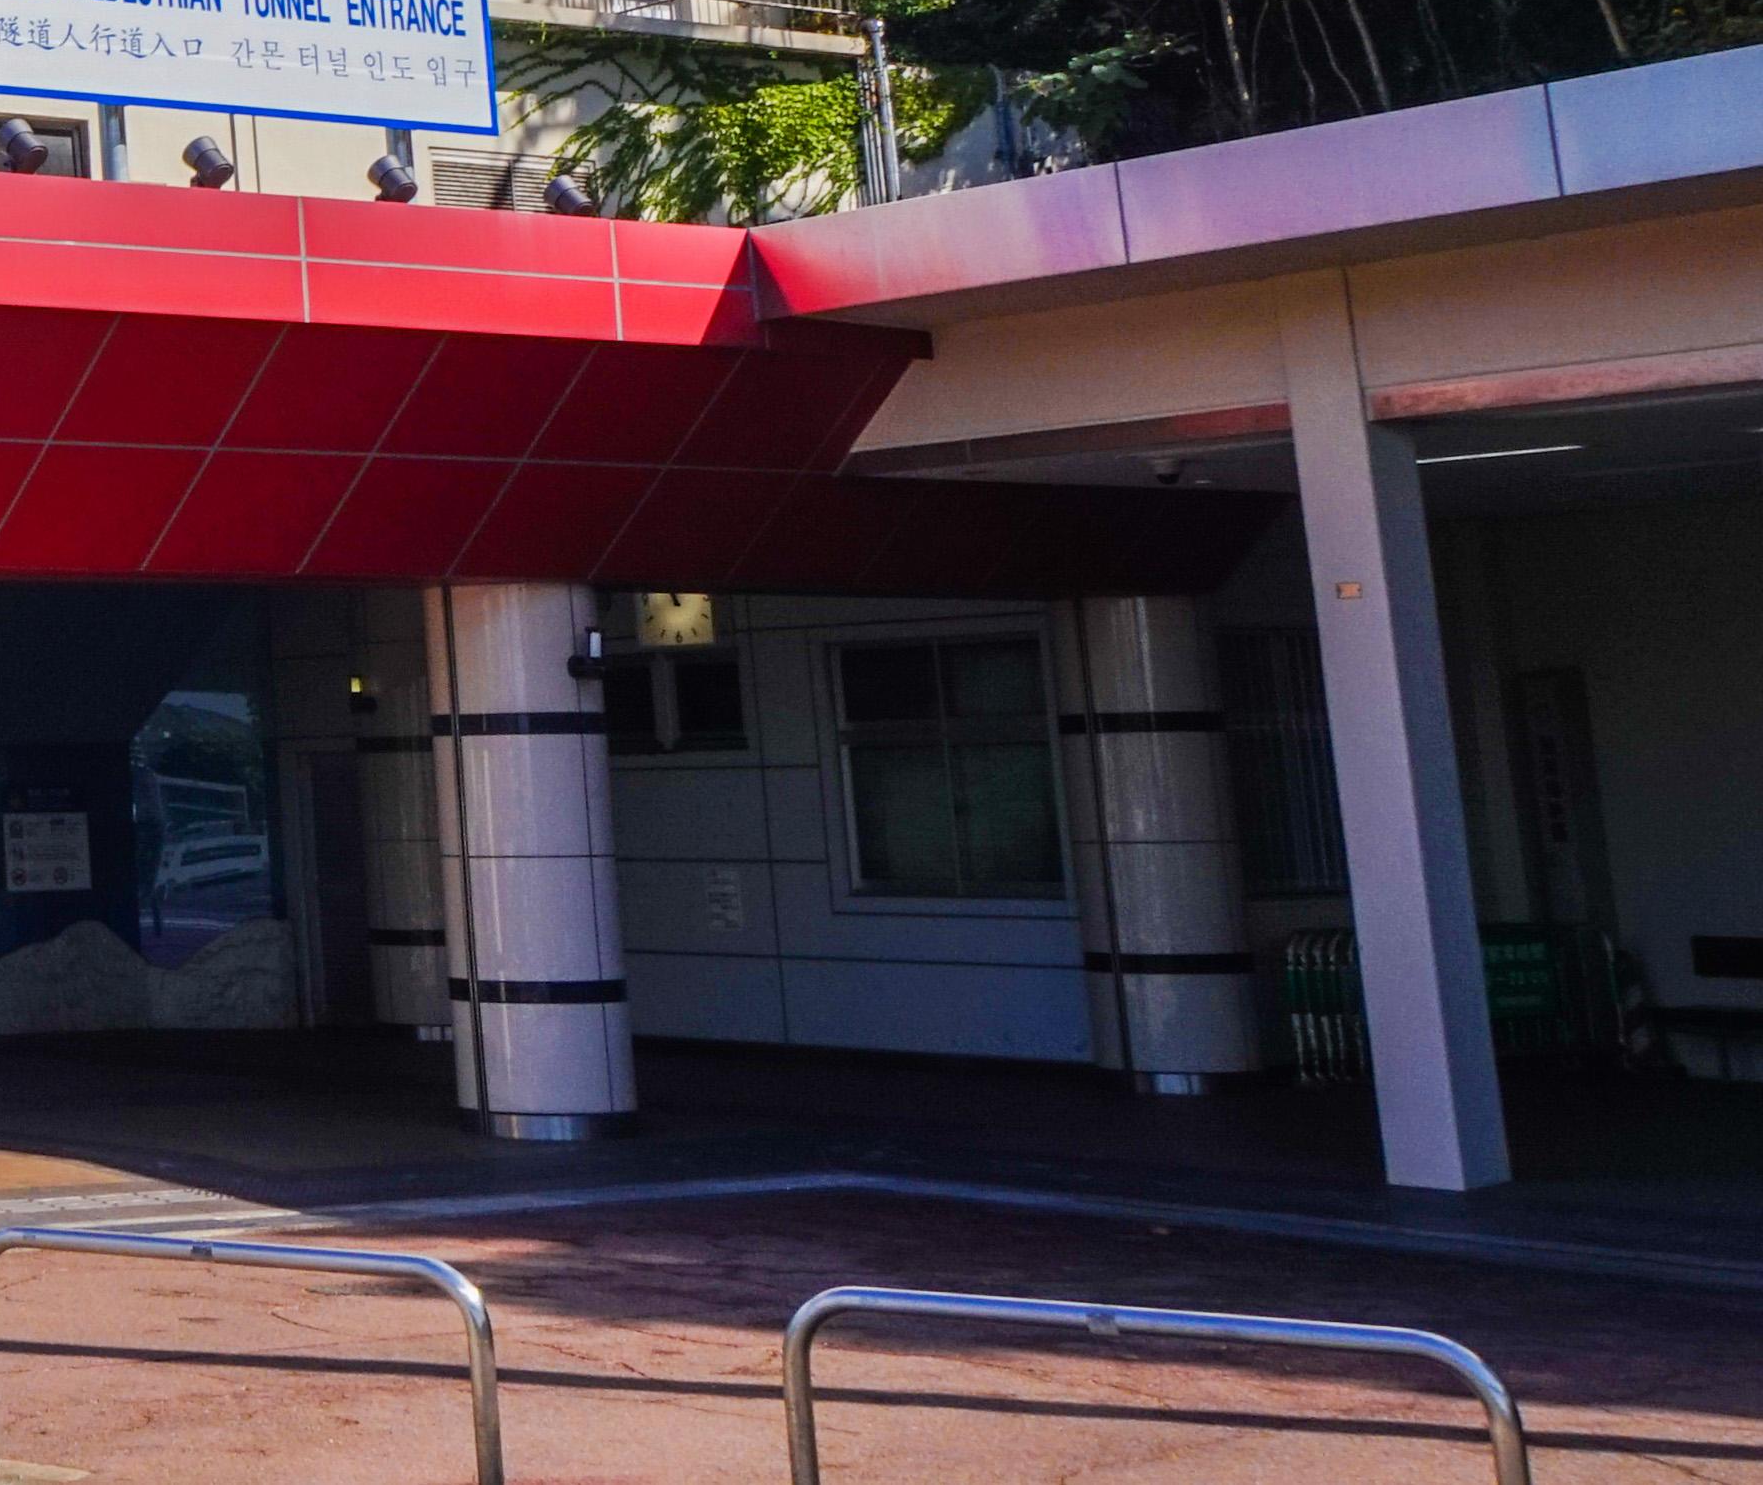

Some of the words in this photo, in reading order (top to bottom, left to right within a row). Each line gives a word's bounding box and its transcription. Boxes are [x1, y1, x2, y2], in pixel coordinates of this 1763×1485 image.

[231, 37, 284, 71] 간몬
[298, 42, 349, 78] 터널
[363, 50, 415, 82] 인도
[426, 56, 476, 88] 입구
